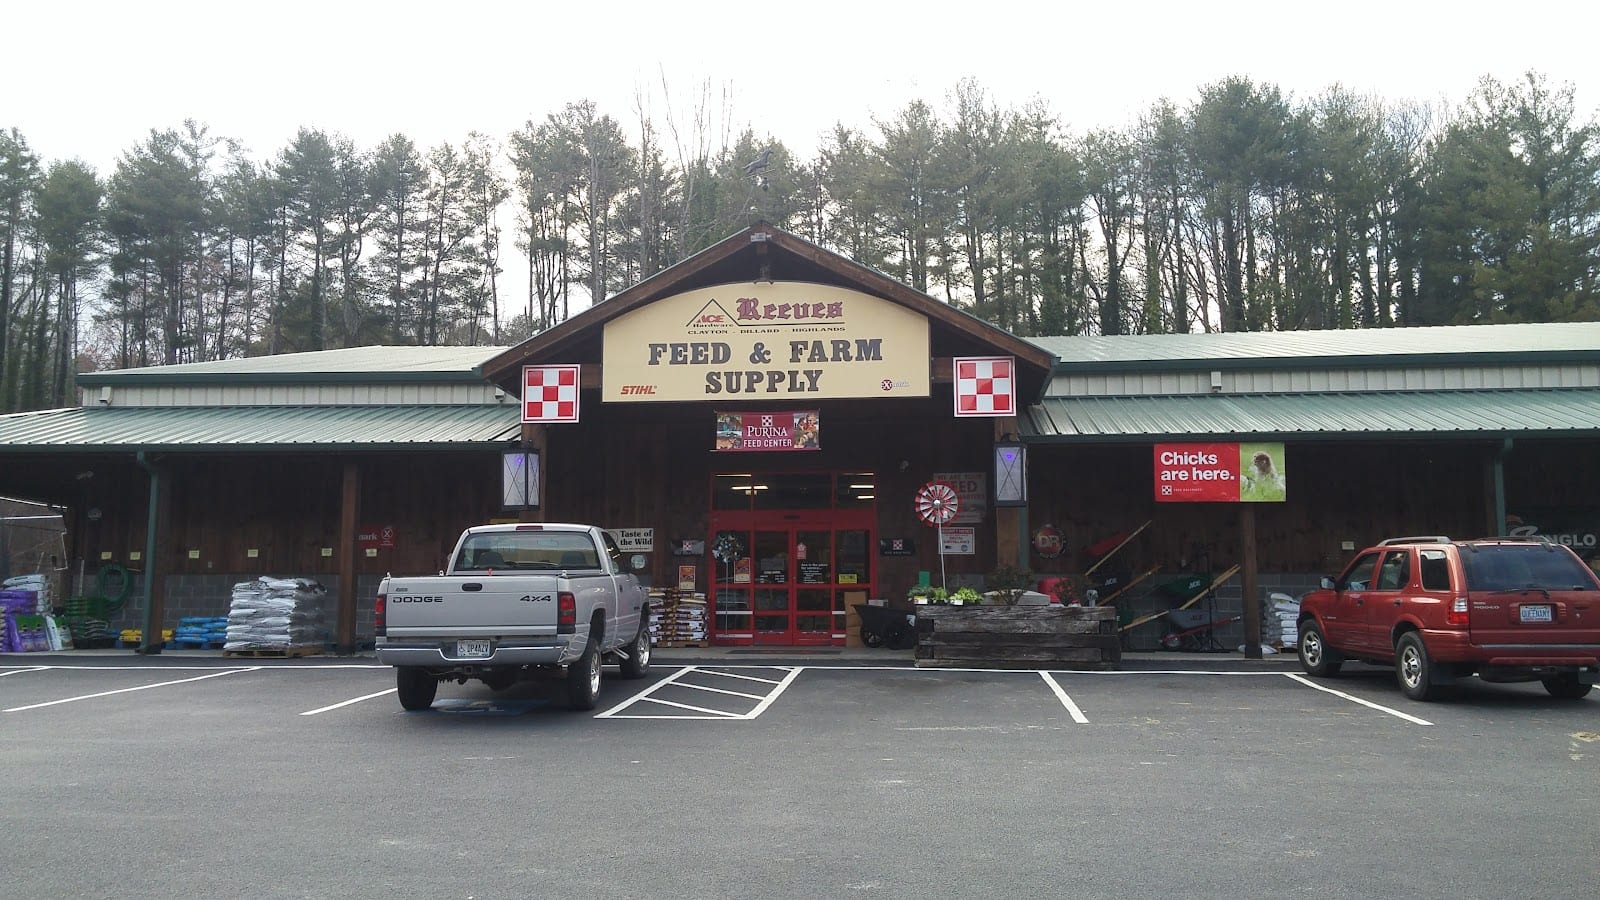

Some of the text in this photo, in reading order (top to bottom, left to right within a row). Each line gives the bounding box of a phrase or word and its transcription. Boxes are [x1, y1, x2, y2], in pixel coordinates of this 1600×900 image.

[735, 297, 844, 321] Reeves
[696, 314, 725, 323] ACE
[648, 338, 883, 366] FEED & FARM
[705, 369, 824, 394] SUPPLY
[620, 385, 656, 395] STIHL
[747, 425, 788, 439] PURINA
[743, 438, 792, 448] FEED CENTER
[1160, 451, 1218, 465] Chicks
[1160, 466, 1235, 481] are here.
[620, 529, 653, 538] Taste of
[620, 538, 632, 546] the
